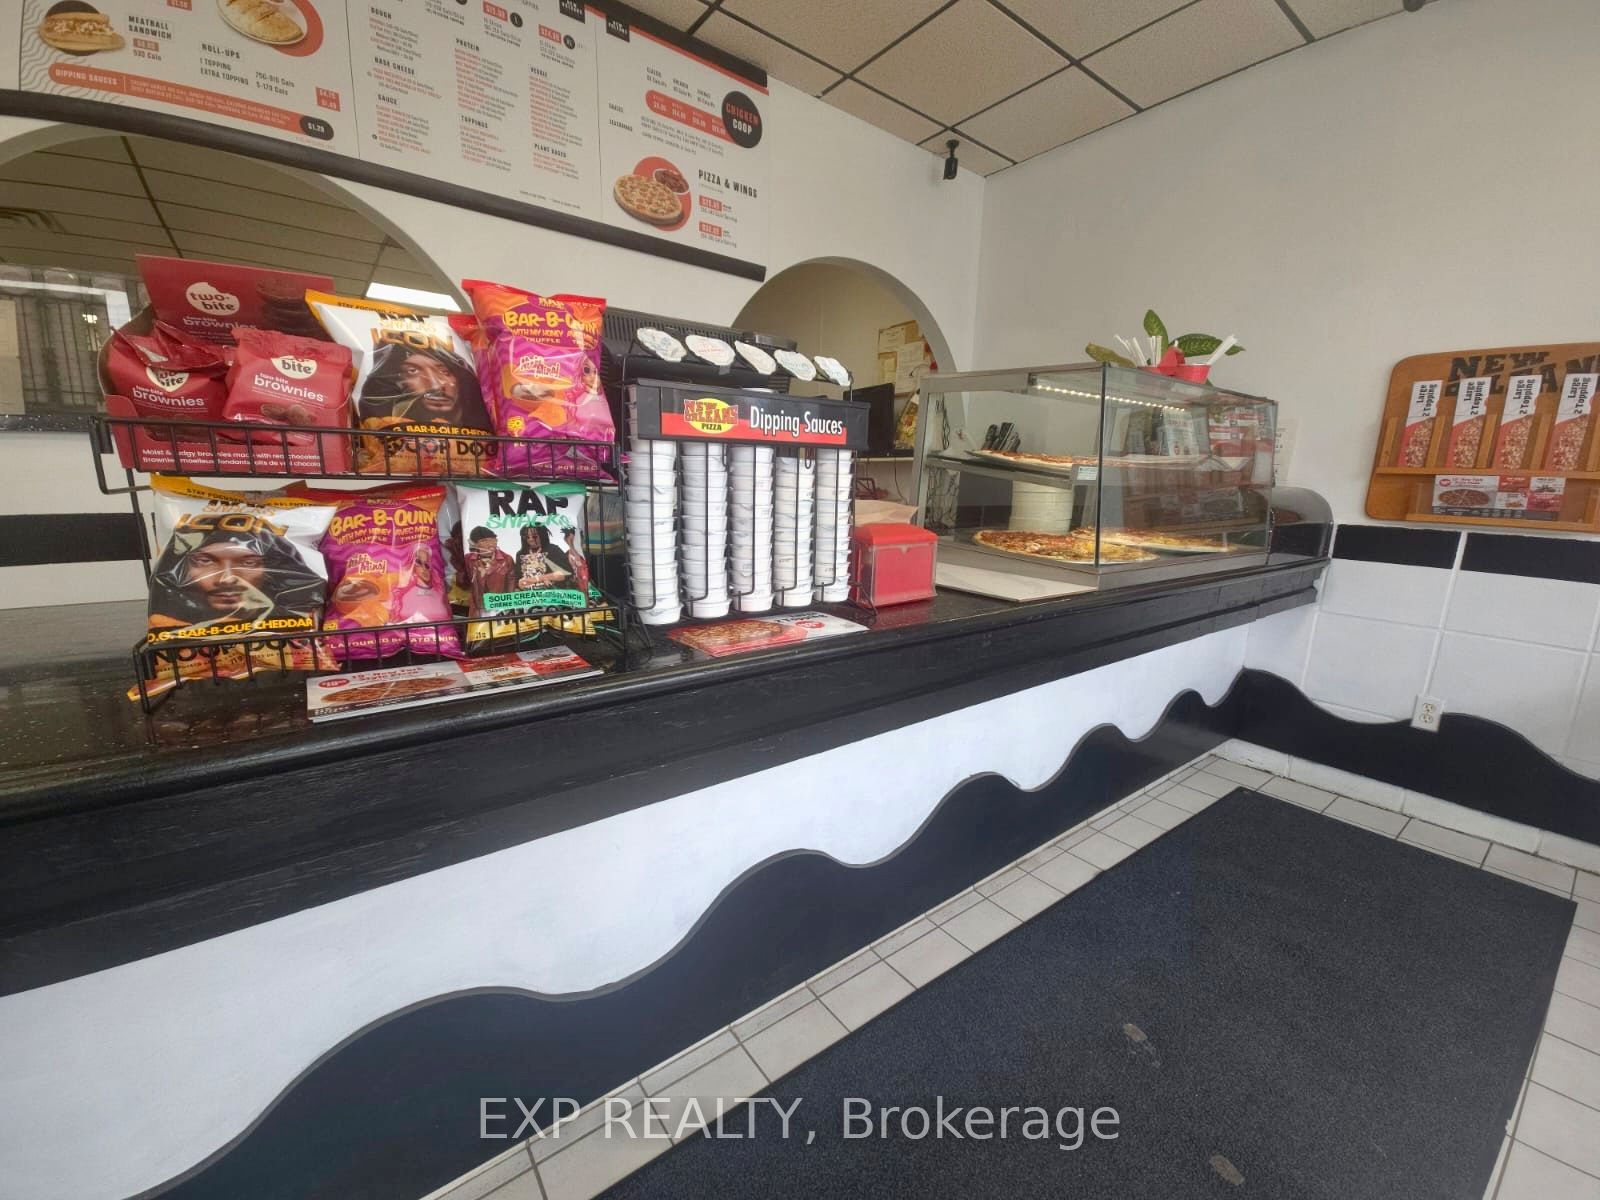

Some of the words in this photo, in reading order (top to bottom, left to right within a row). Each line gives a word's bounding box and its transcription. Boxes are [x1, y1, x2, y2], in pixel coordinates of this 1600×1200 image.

[128, 15, 169, 31] MEATBALL
[128, 24, 172, 40] SANDWICH
[201, 43, 240, 59] ROLL-UPS
[55, 68, 87, 80] DIPPING
[88, 74, 118, 86] SAUCES
[726, 102, 760, 126] CHICKEN
[732, 118, 752, 135] COOP
[698, 169, 721, 186] PIZZA
[724, 178, 730, 189] &
[733, 181, 757, 198] WINGS
[202, 300, 236, 311] bite
[369, 328, 455, 352] ICON
[281, 359, 312, 374] bite
[1446, 351, 1550, 382] NEW
[132, 387, 205, 407] brownies
[254, 374, 324, 402] brownies
[1416, 384, 1428, 403] Large
[1424, 384, 1437, 411] Topping
[1463, 382, 1475, 401] Large
[1471, 381, 1485, 410] Topping
[1513, 379, 1525, 399] Large
[1520, 379, 1535, 409] Topping
[1568, 377, 1580, 398] Large
[1575, 377, 1591, 409] Topping
[701, 423, 722, 431] PIZZA
[750, 406, 800, 437] Dipping
[804, 411, 843, 435] Sauces
[487, 489, 569, 518] RAP
[175, 513, 290, 537] ICON
[488, 592, 512, 603] SOUR
[513, 591, 542, 600] CREAM
[177, 621, 251, 638] BAR-B-QUE
[255, 616, 313, 631] CHEDDAR
